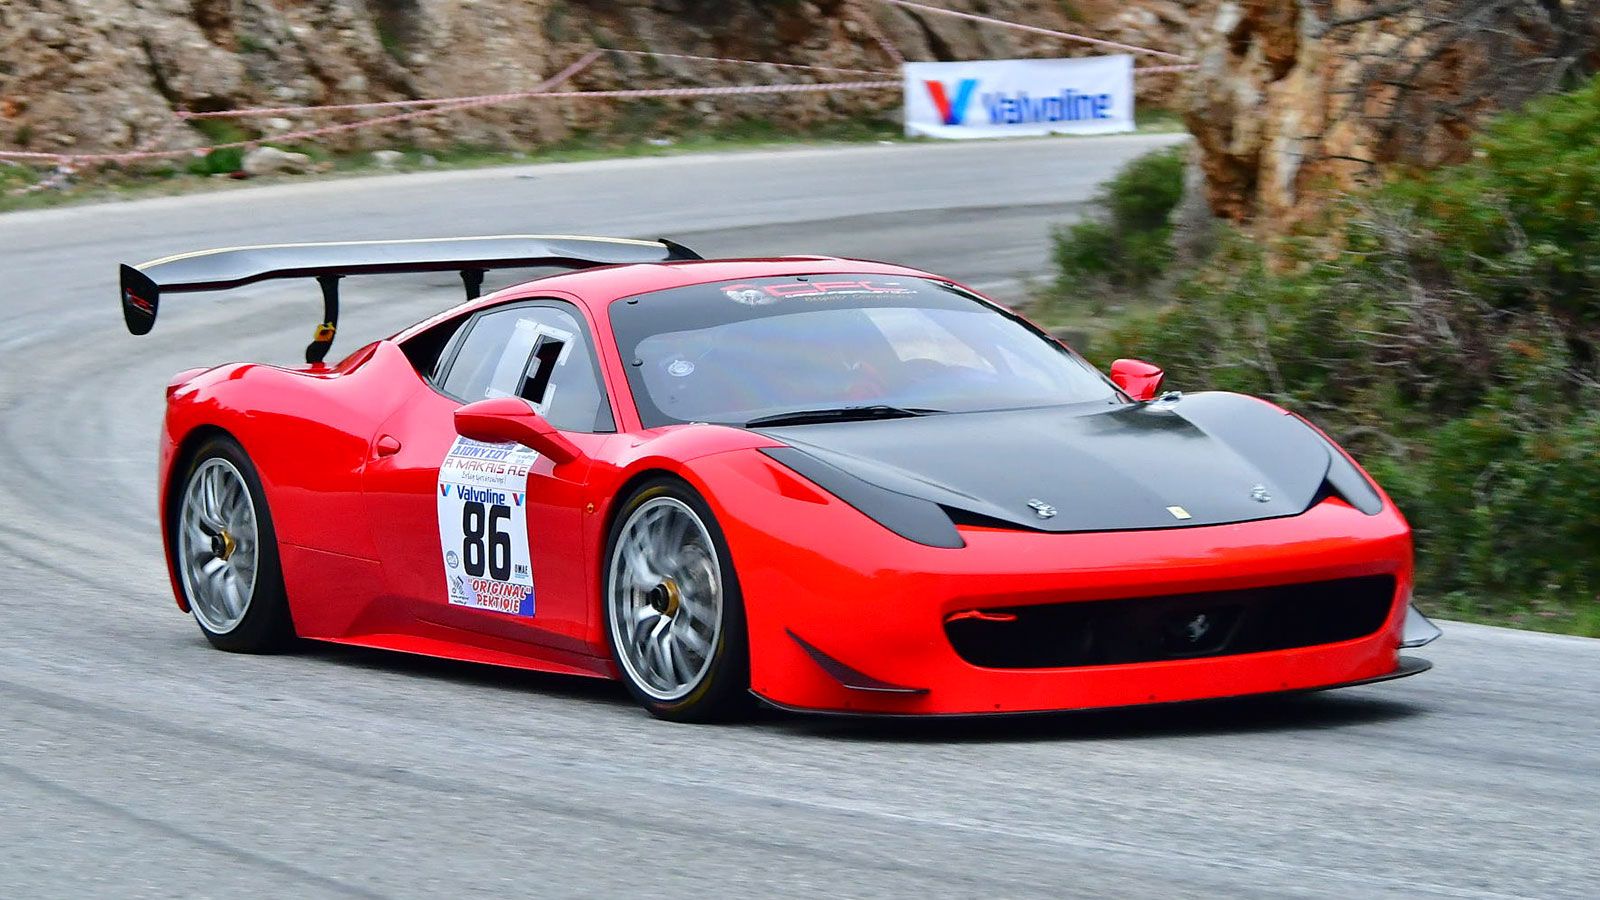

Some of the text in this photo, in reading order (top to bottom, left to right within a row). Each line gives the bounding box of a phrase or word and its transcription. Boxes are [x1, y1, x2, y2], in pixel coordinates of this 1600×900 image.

[982, 89, 1113, 124] Valvoline
[457, 484, 506, 505] Valvoline
[462, 501, 511, 581] 86
